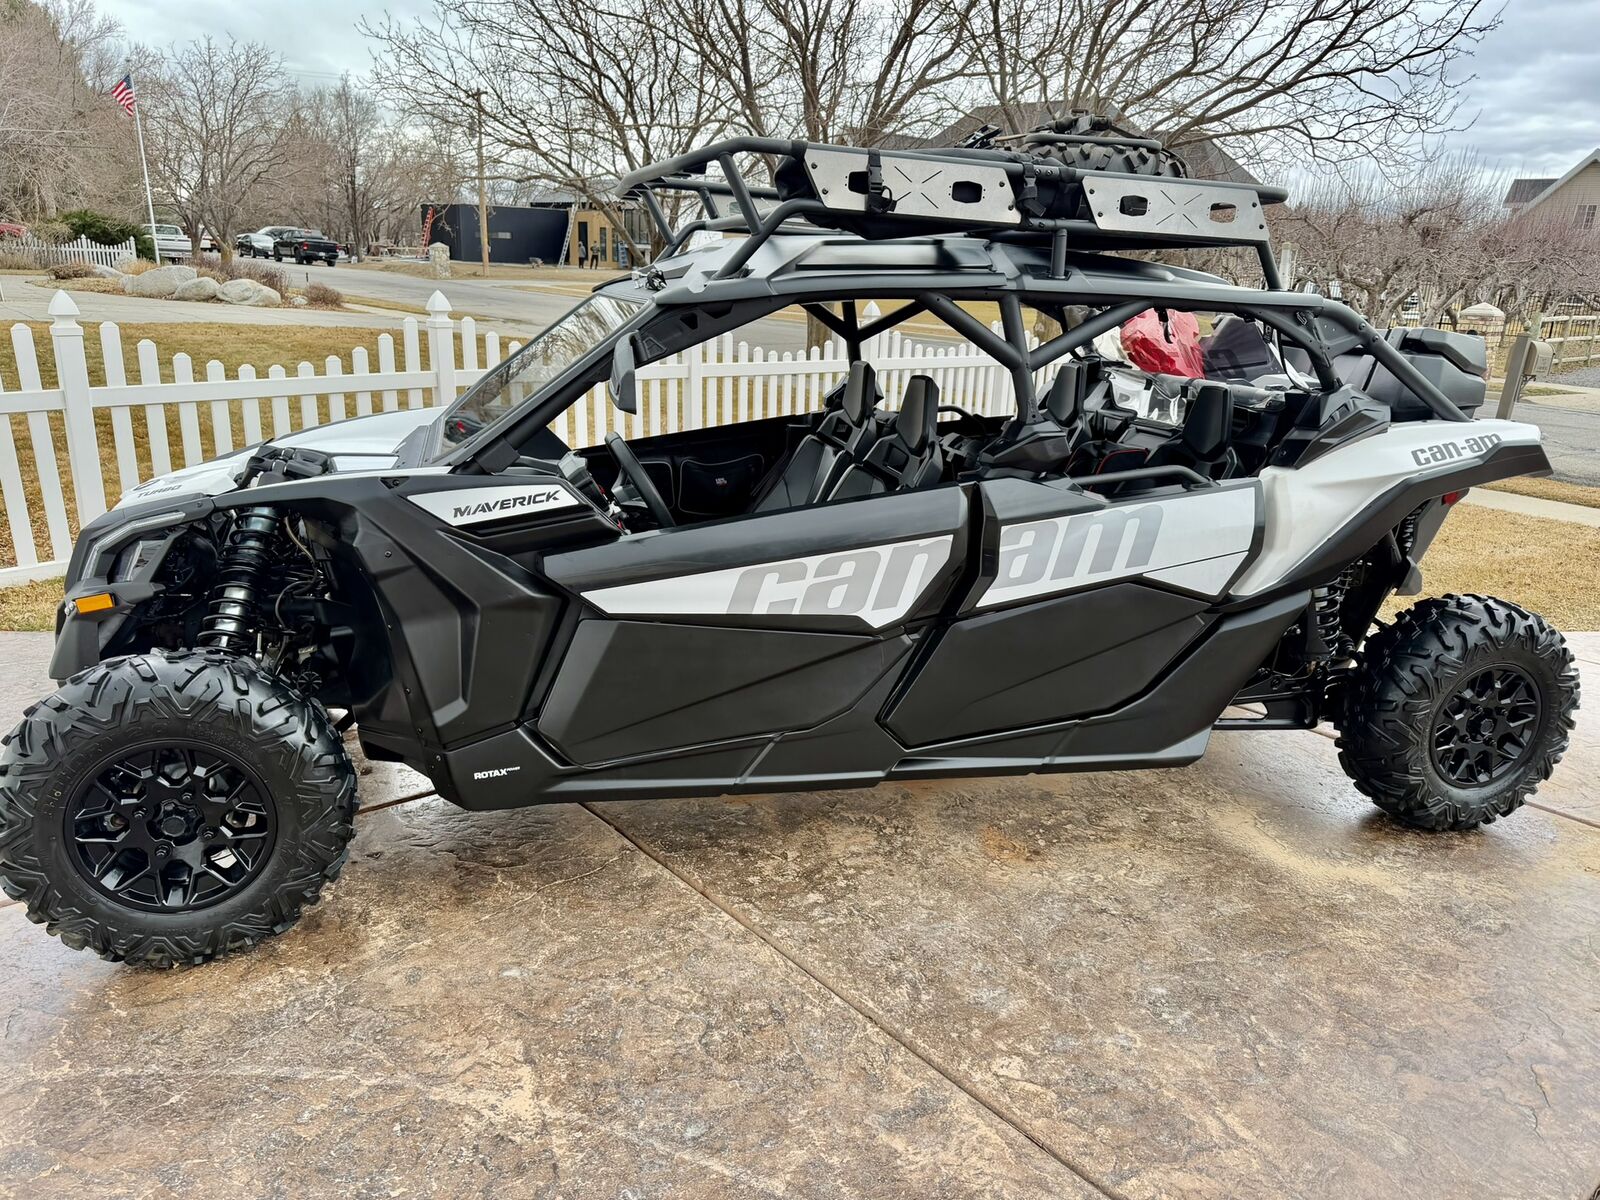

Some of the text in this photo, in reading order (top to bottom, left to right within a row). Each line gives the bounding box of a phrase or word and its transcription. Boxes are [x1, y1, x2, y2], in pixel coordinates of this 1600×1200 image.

[1411, 433, 1502, 467] can-am
[453, 490, 561, 518] MAVERICK
[474, 768, 507, 780] ROTAX
